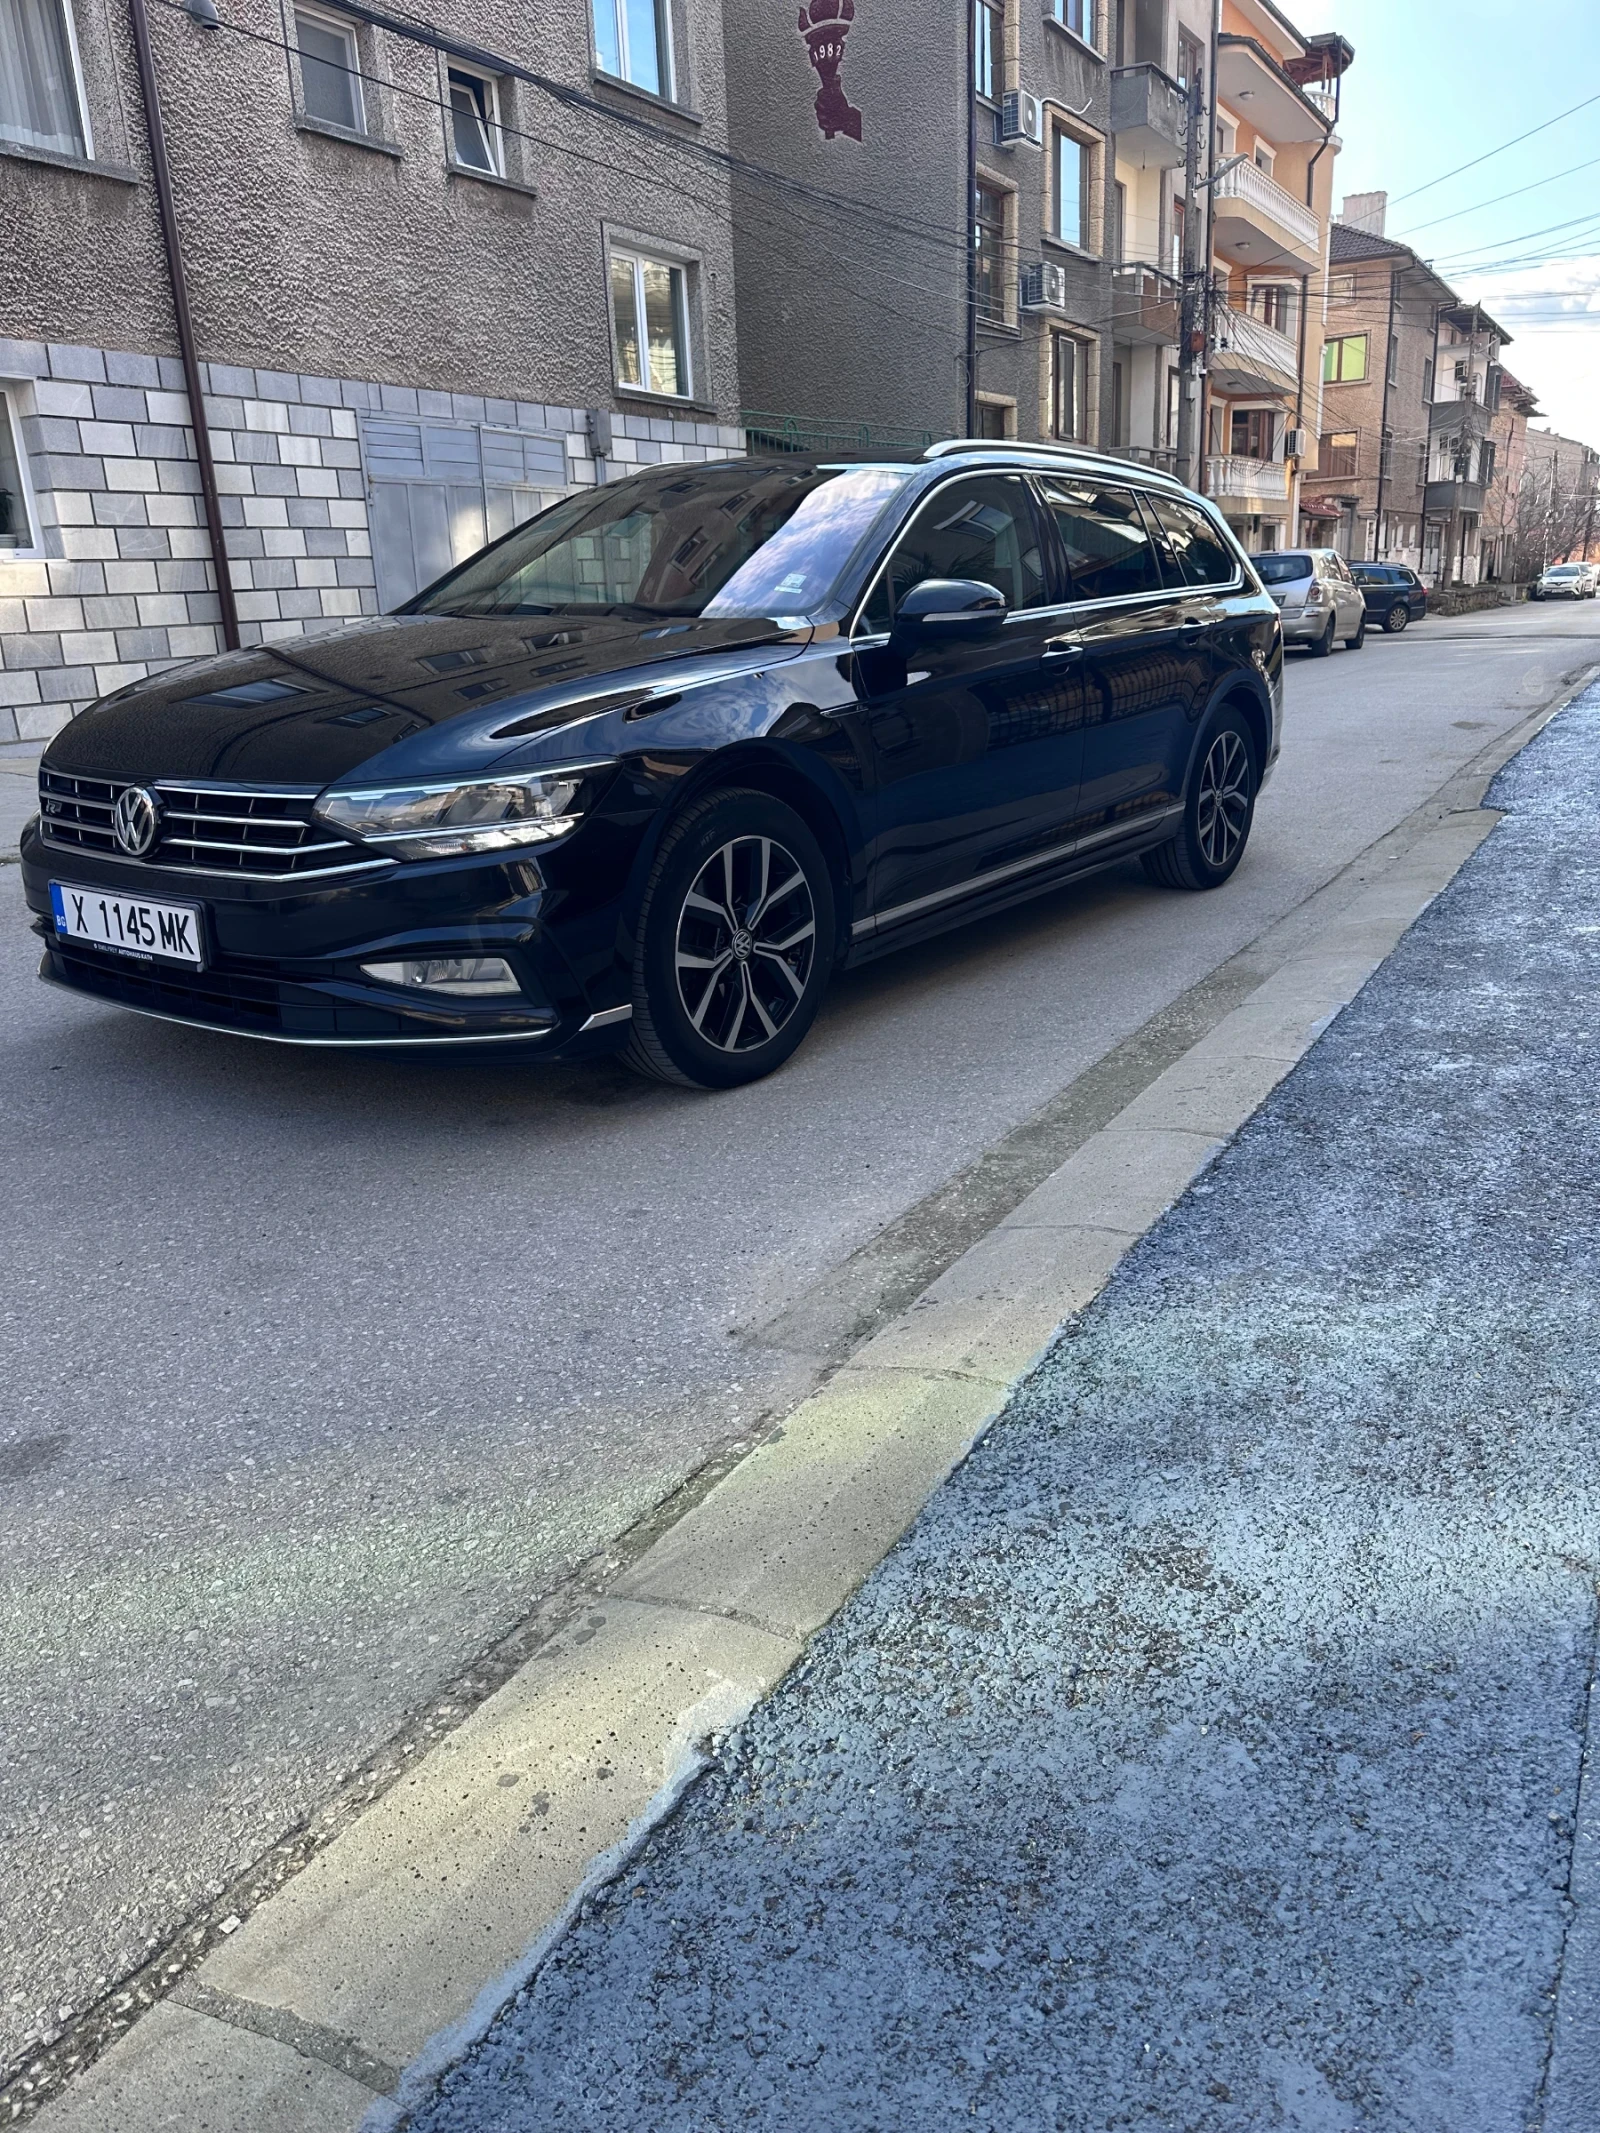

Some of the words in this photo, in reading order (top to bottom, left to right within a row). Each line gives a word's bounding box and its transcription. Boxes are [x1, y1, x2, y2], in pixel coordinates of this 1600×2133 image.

[813, 42, 842, 61] 1982
[56, 914, 66, 927] BG
[71, 893, 89, 934] X
[99, 900, 155, 947] 1145
[158, 910, 195, 955] MK
